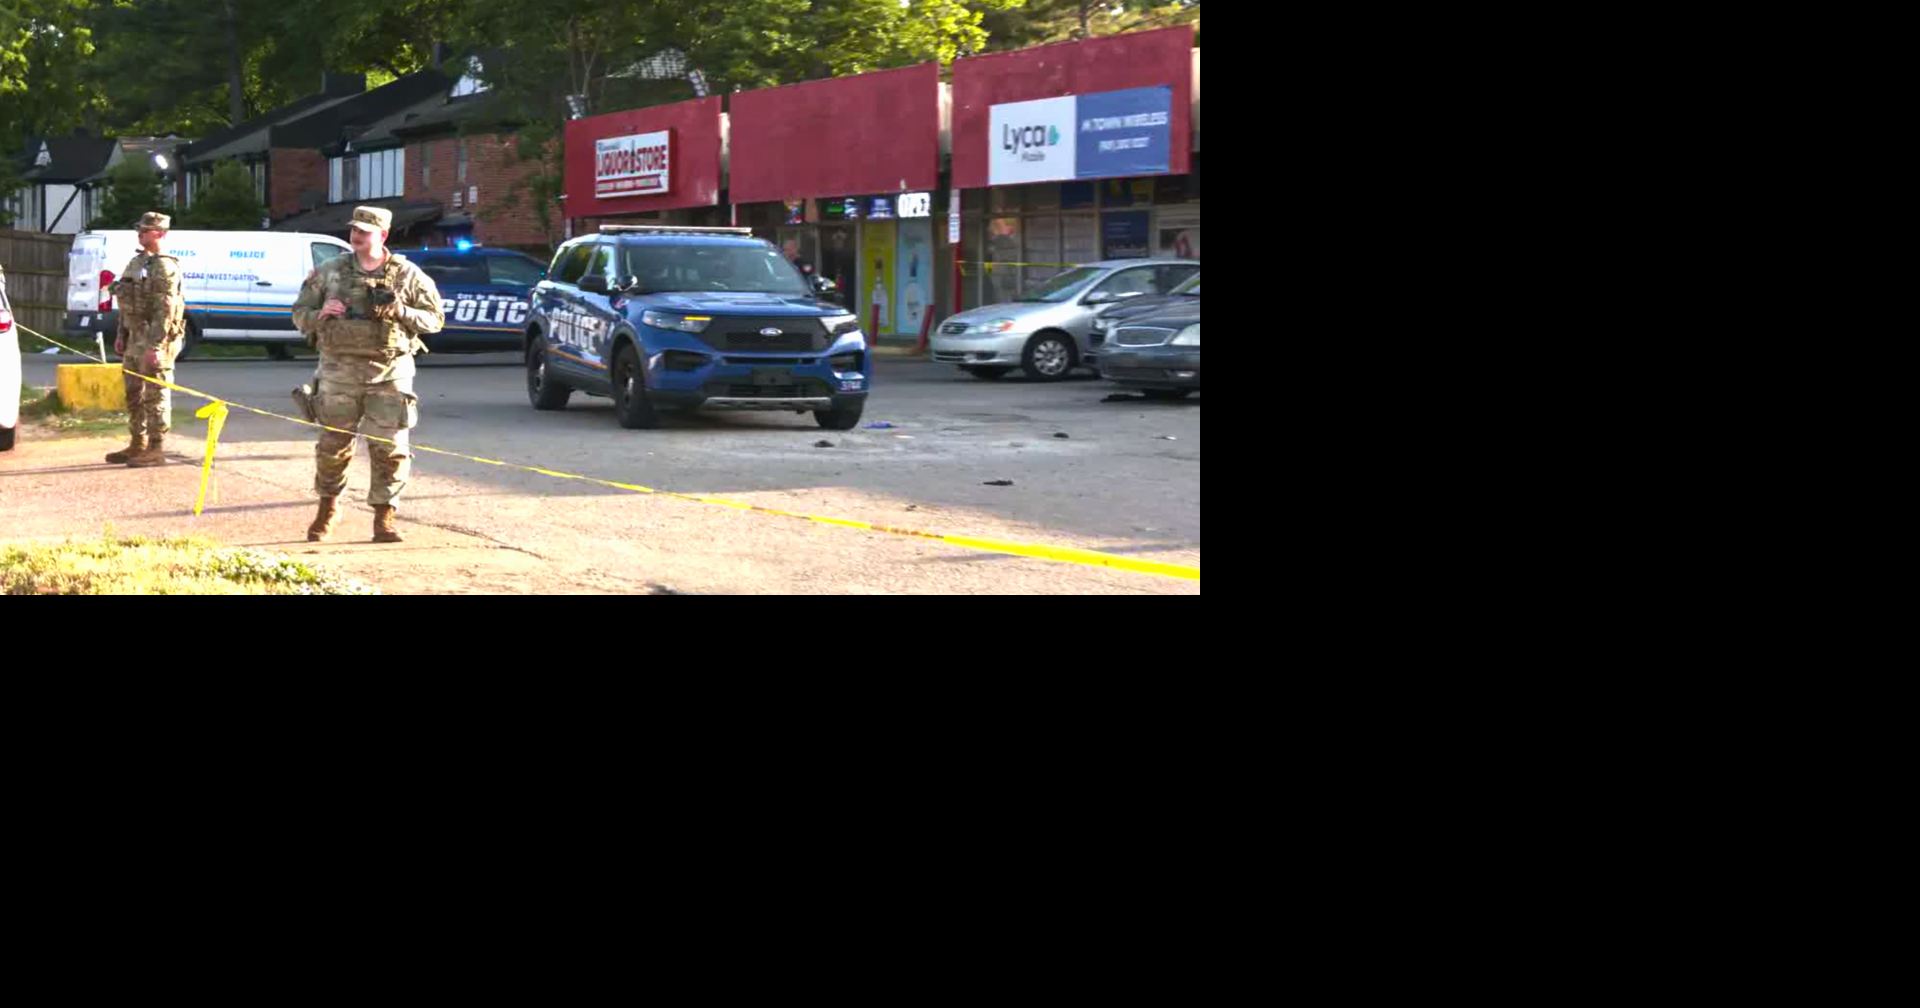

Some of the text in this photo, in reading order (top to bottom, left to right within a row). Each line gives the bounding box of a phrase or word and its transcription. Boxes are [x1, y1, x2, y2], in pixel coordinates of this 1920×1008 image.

[1003, 124, 1047, 154] Lyca
[597, 145, 666, 177] LIQUOR STORE
[229, 250, 266, 259] POLICE
[183, 271, 260, 281] SCENE INVESTIGATION
[441, 299, 528, 323] POLIC
[549, 307, 599, 352] POLICE
